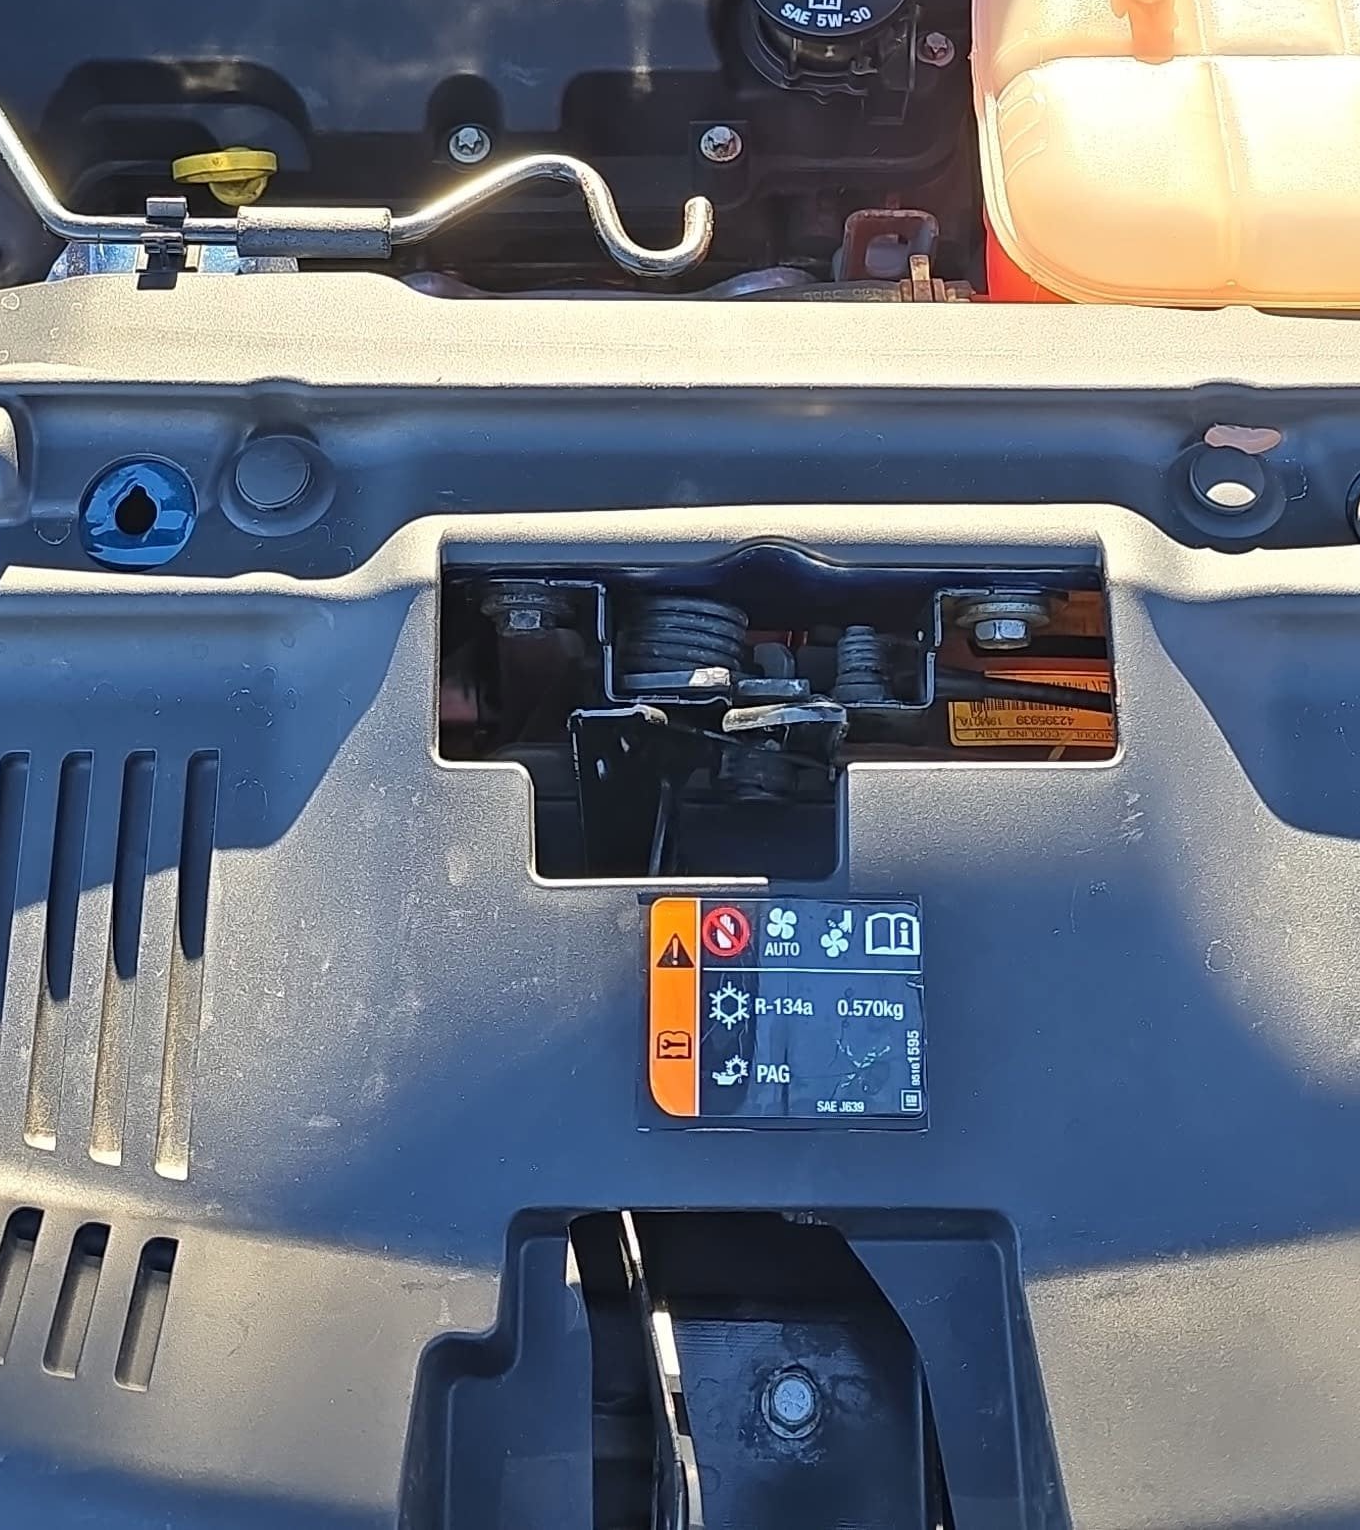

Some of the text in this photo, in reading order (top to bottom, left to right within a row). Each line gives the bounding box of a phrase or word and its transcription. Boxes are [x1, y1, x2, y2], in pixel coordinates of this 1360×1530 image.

[780, 2, 872, 28] SAE 5W-30
[764, 941, 800, 957] AUTO
[754, 998, 904, 1021] R-134a 0.570kg
[756, 1064, 790, 1083] PAG
[816, 1100, 865, 1113] SAE J639
